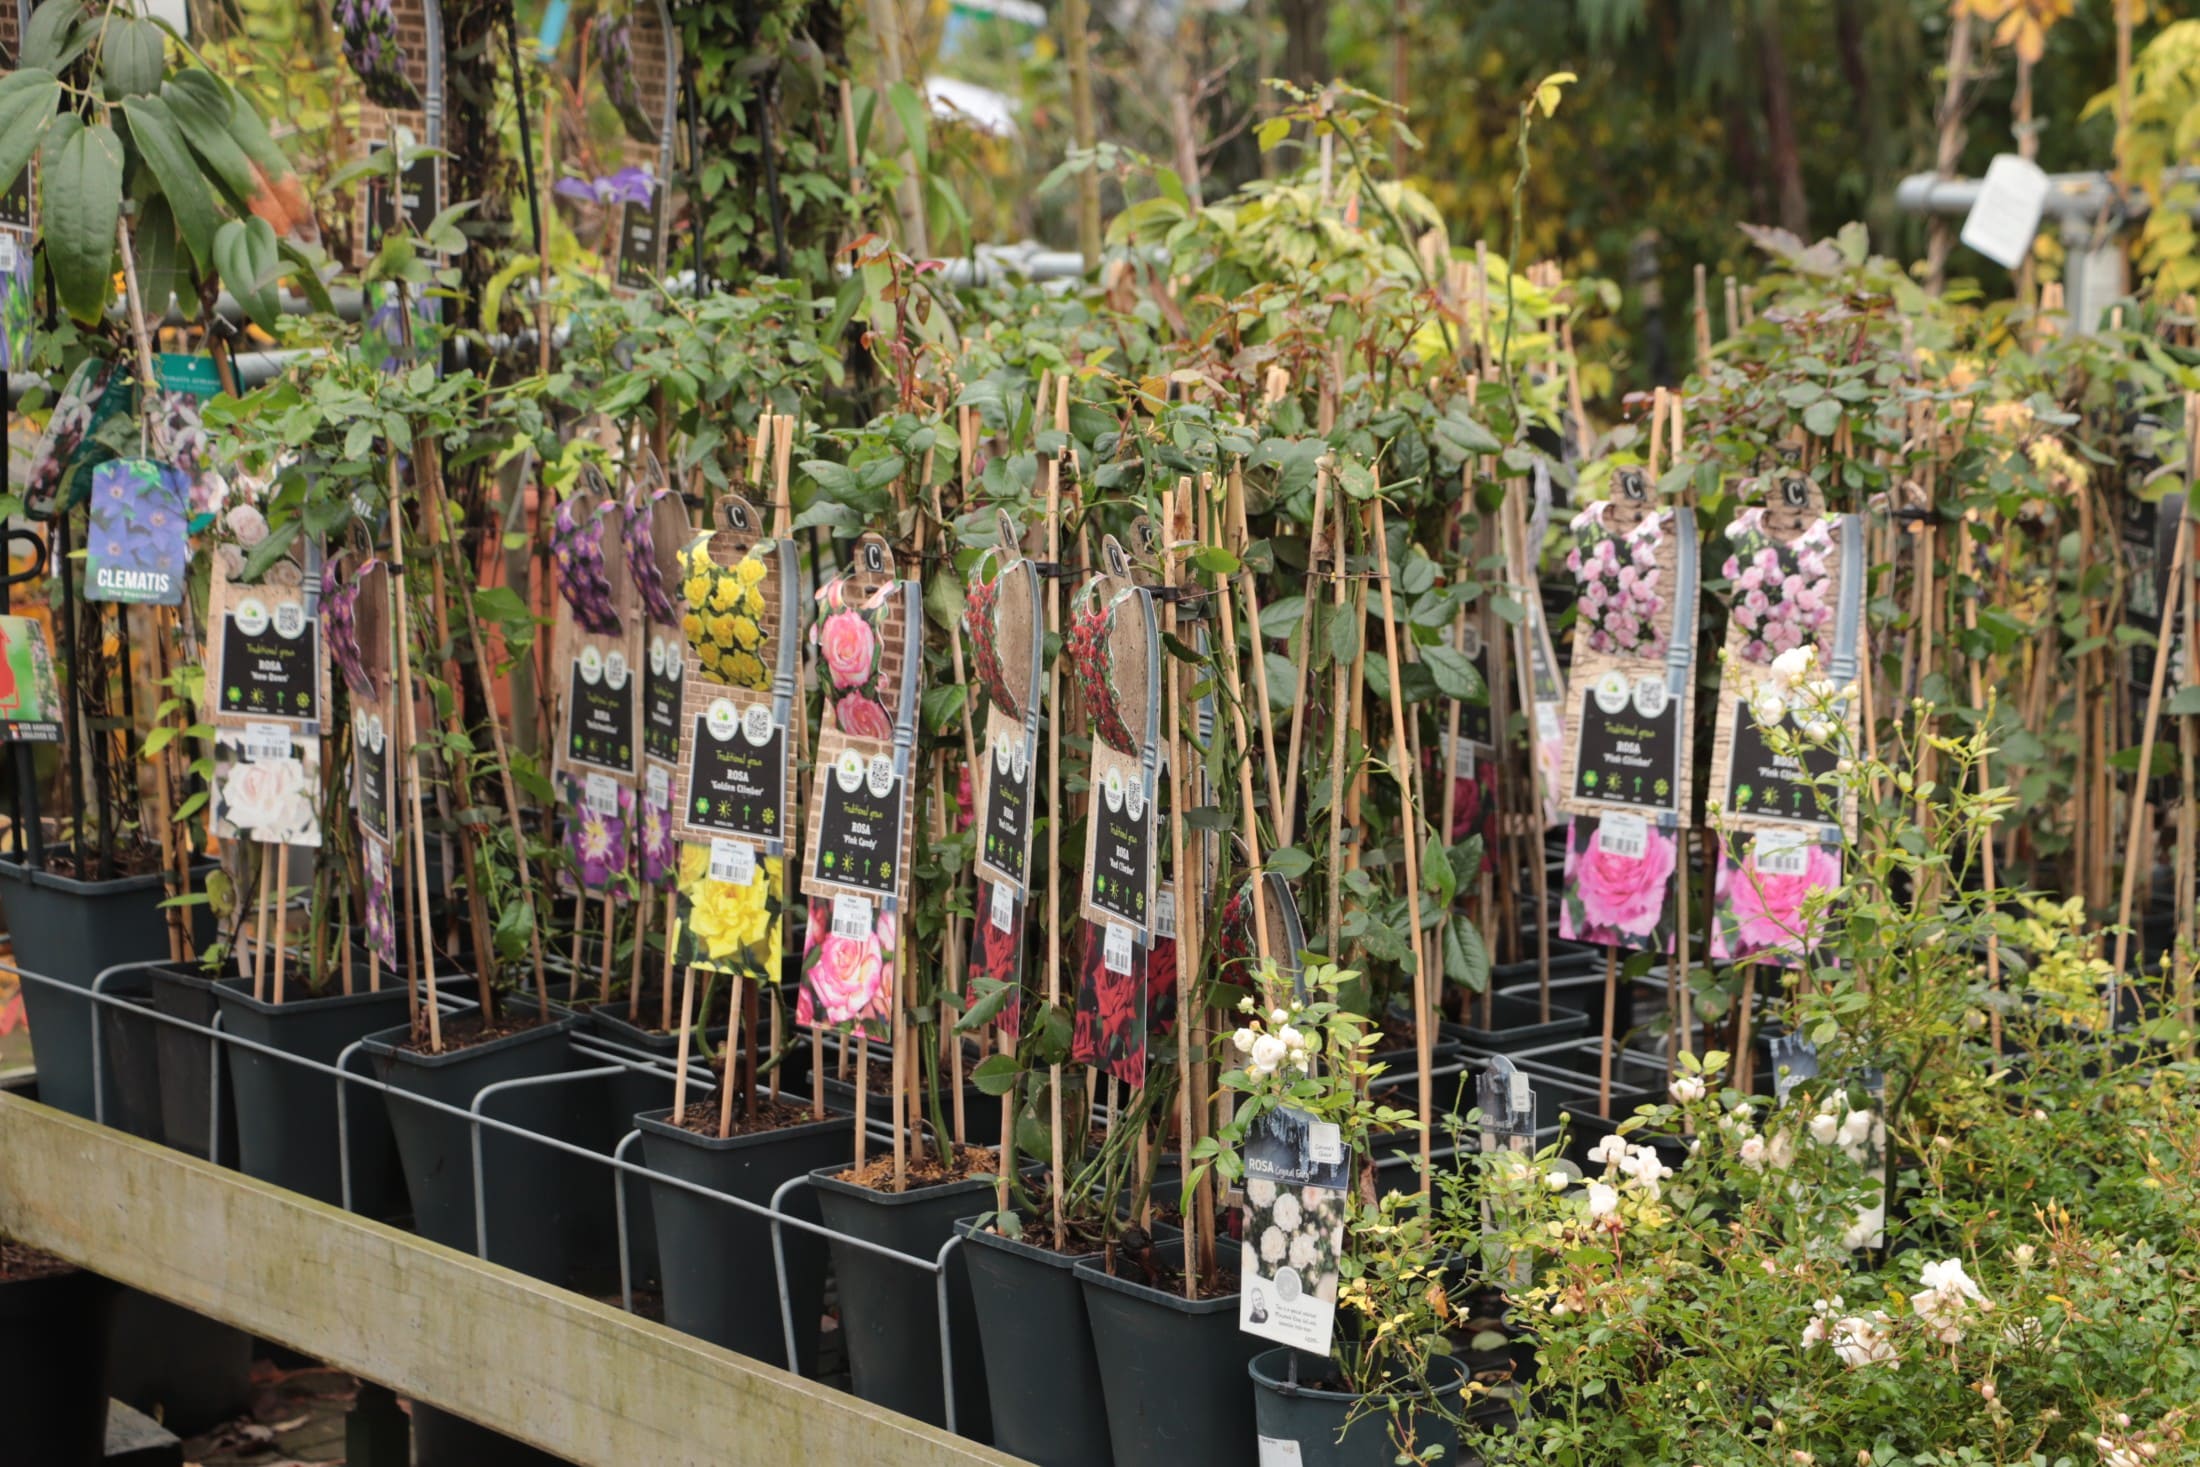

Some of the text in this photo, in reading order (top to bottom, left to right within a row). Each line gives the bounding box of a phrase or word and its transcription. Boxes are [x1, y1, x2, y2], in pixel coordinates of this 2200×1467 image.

[1627, 476, 1641, 499] C
[1788, 481, 1803, 504] C
[731, 507, 744, 527] C
[869, 546, 880, 569] C
[1112, 550, 1122, 573] C
[97, 567, 169, 592] CLEMATIS
[258, 659, 282, 672] ROSA
[727, 769, 749, 782] ROSA
[711, 780, 764, 797] 'Golden Climber'
[851, 821, 871, 835] ROSA
[843, 834, 877, 850] 'Pink Candy'
[1116, 844, 1130, 861] ROSA
[1248, 1158, 1274, 1173] ROSA
